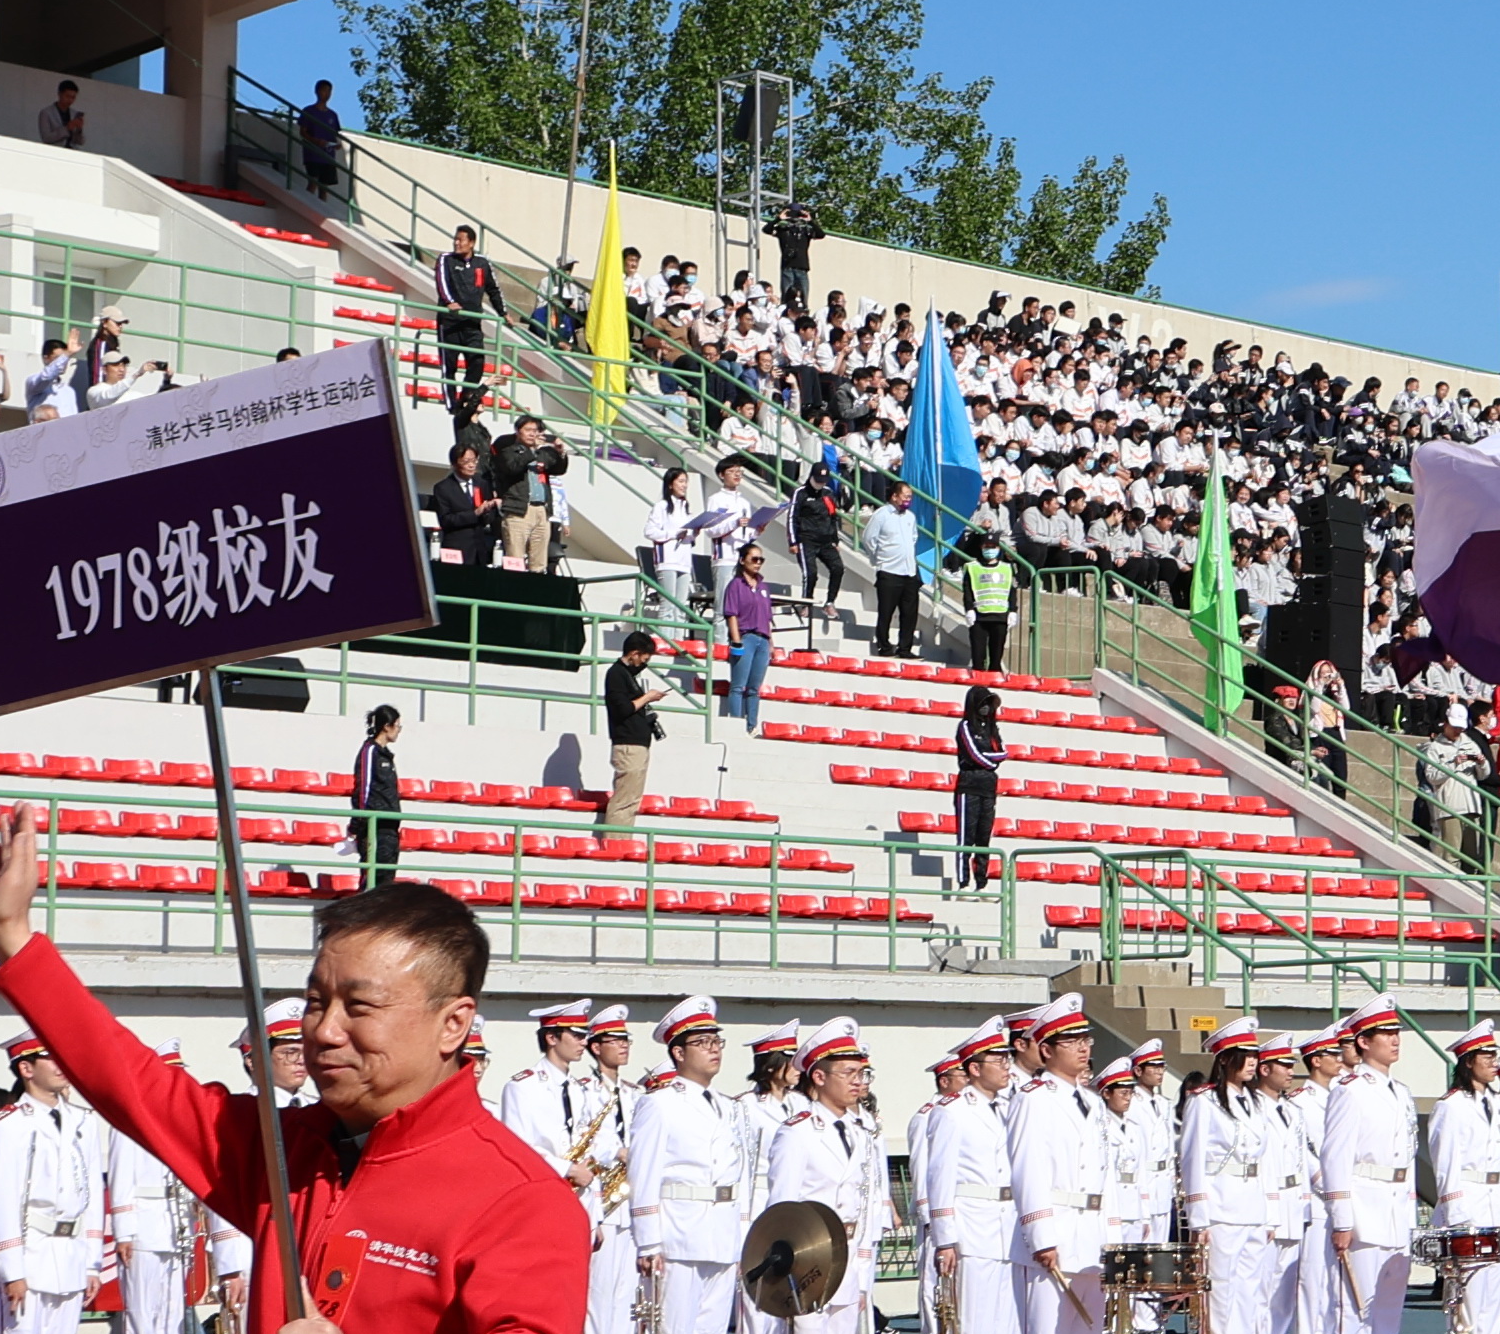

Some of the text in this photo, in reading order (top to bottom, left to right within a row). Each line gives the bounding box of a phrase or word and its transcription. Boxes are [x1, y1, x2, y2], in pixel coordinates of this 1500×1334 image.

[145, 372, 379, 451] 清华大学马约翰杯学生运动会
[44, 492, 335, 642] 1978级校友
